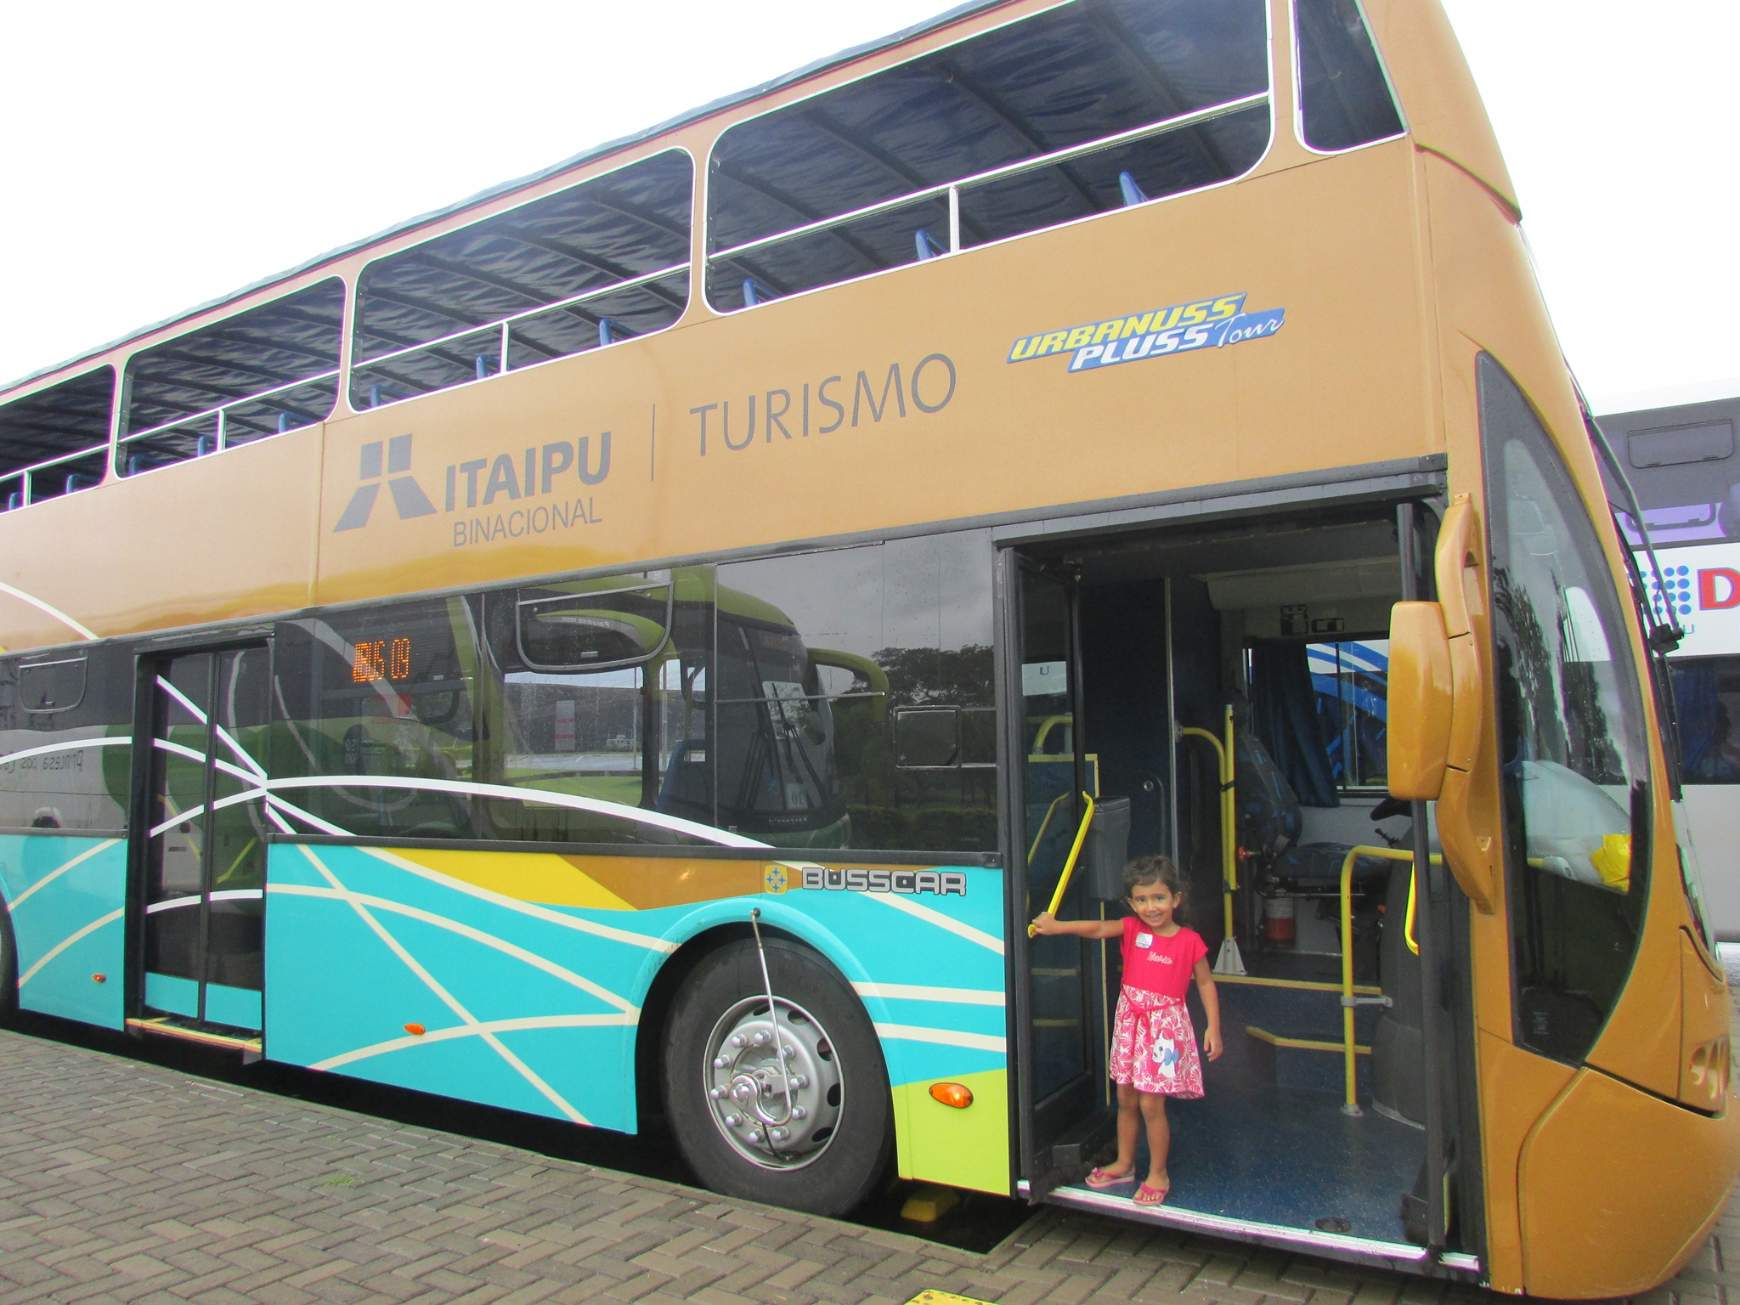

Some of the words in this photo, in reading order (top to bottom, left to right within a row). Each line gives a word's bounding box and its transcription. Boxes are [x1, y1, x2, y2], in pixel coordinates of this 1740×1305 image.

[1009, 294, 1243, 361] URBANUSS
[1071, 322, 1214, 370] PLUSS
[1213, 312, 1285, 348] Tour
[689, 352, 957, 457] TURISMO
[445, 431, 612, 512] ITAIPU
[453, 496, 603, 547] BINACIONAL
[802, 867, 967, 897] BUSSCAR
